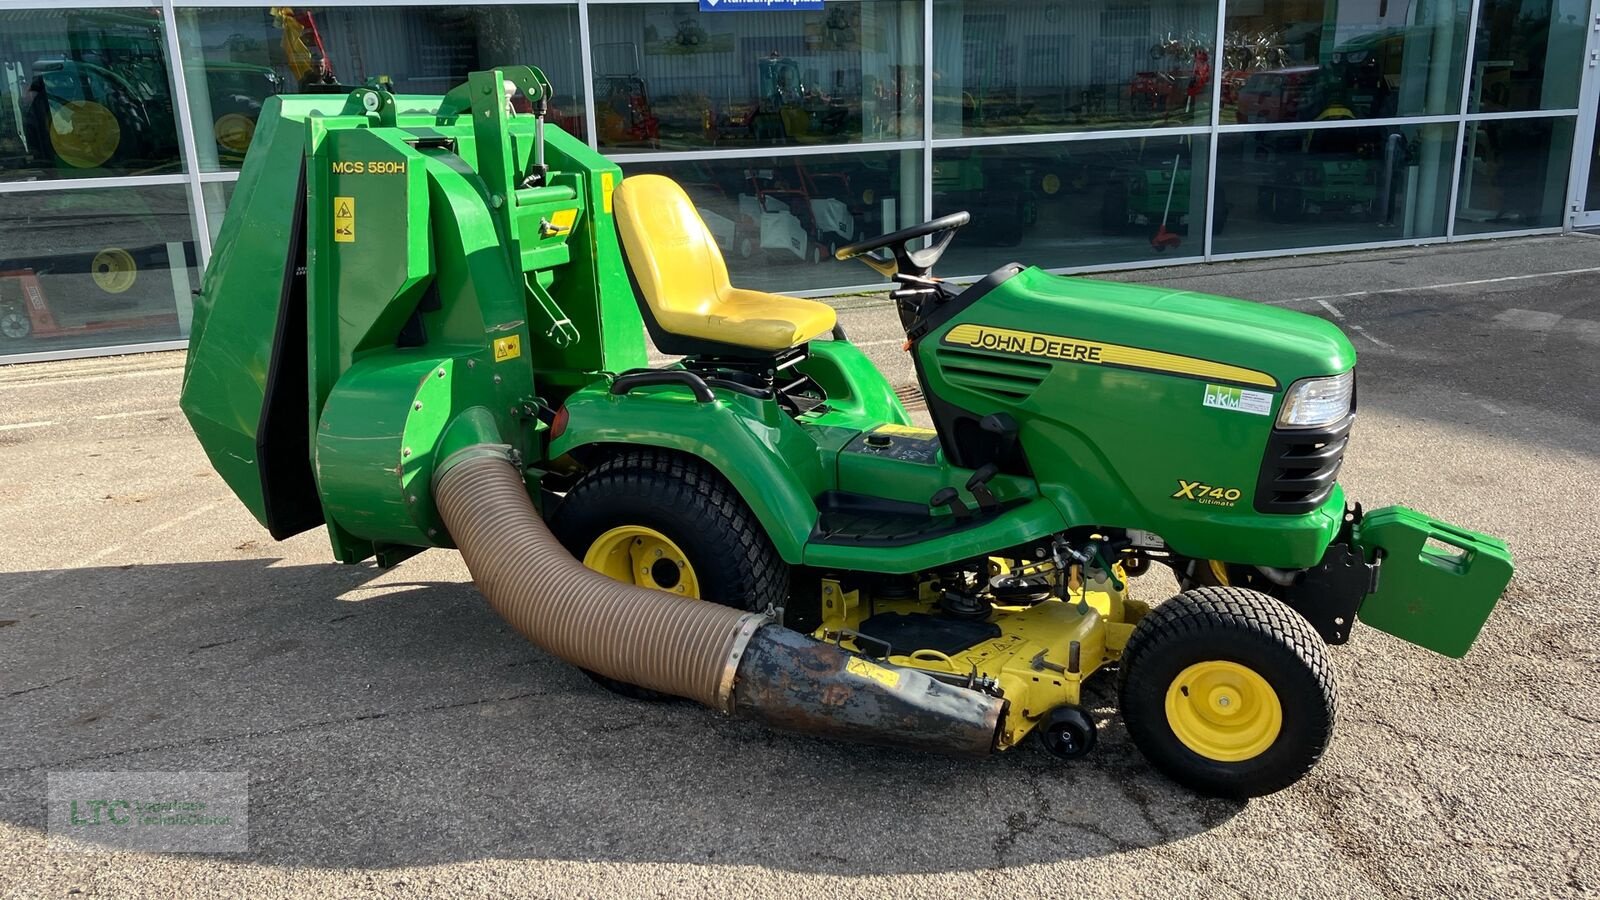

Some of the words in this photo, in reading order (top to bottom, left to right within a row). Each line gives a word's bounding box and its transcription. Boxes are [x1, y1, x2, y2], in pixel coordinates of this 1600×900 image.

[332, 161, 364, 173] MCS
[367, 161, 405, 173] 580H
[971, 330, 1026, 352] JOHN
[1030, 336, 1102, 361] DEERE
[1206, 393, 1240, 408] RKM
[1173, 480, 1241, 500] X740
[1199, 499, 1235, 507] Ultimate
